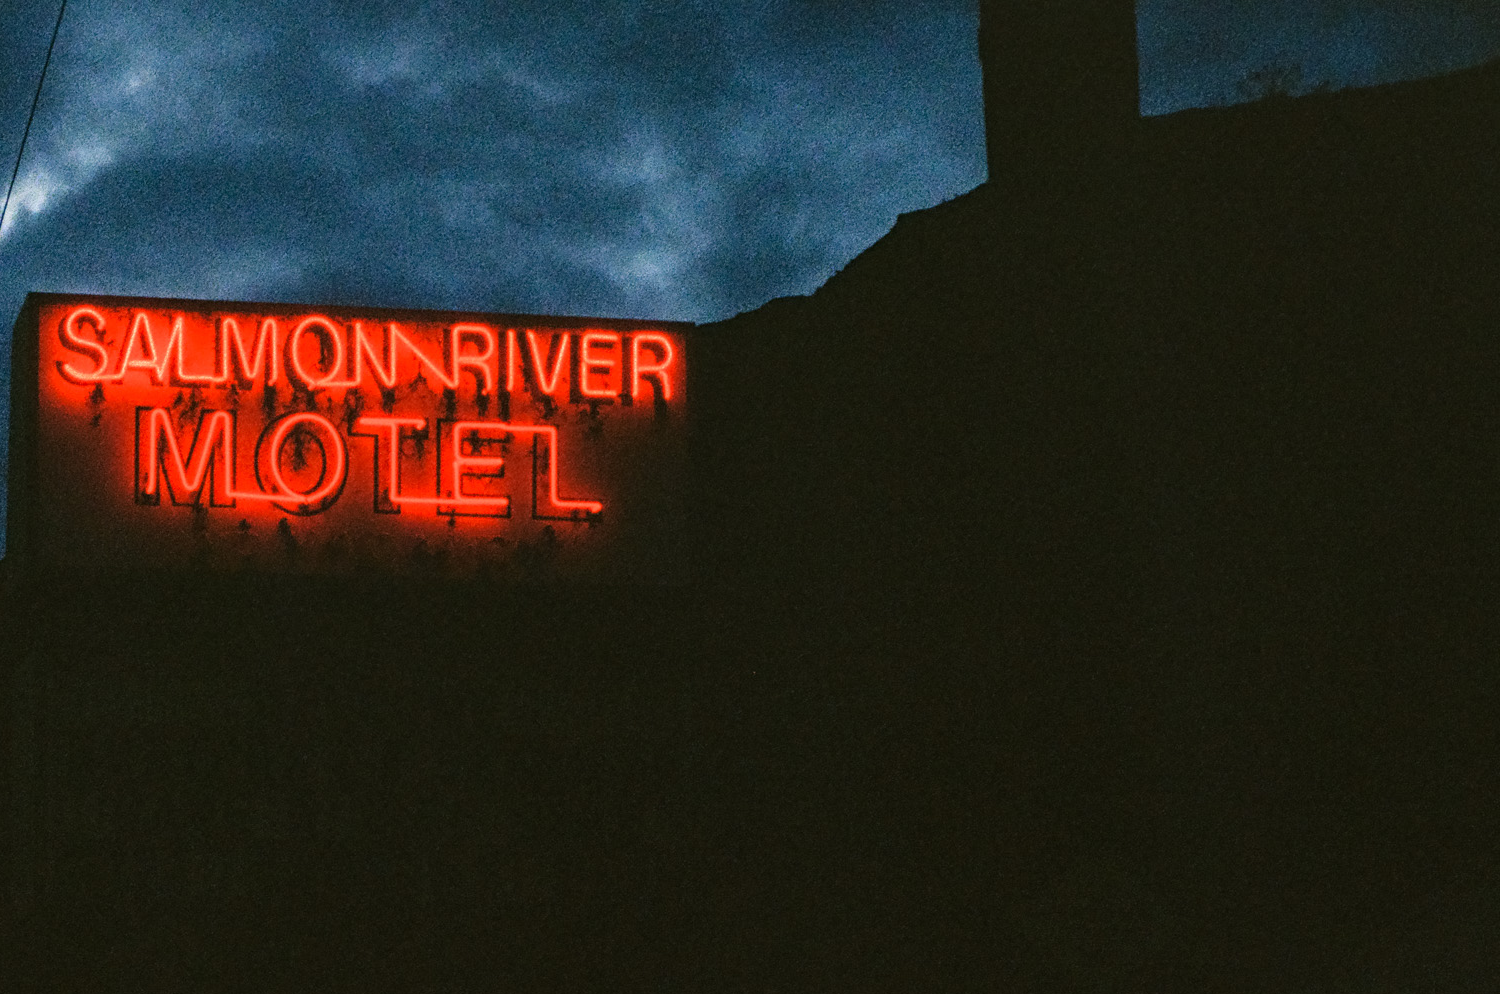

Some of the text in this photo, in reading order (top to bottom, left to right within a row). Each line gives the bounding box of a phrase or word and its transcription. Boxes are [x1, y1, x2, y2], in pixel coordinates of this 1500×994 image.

[57, 306, 675, 402] SALMON RIVER
[135, 406, 603, 521] MOTEL
